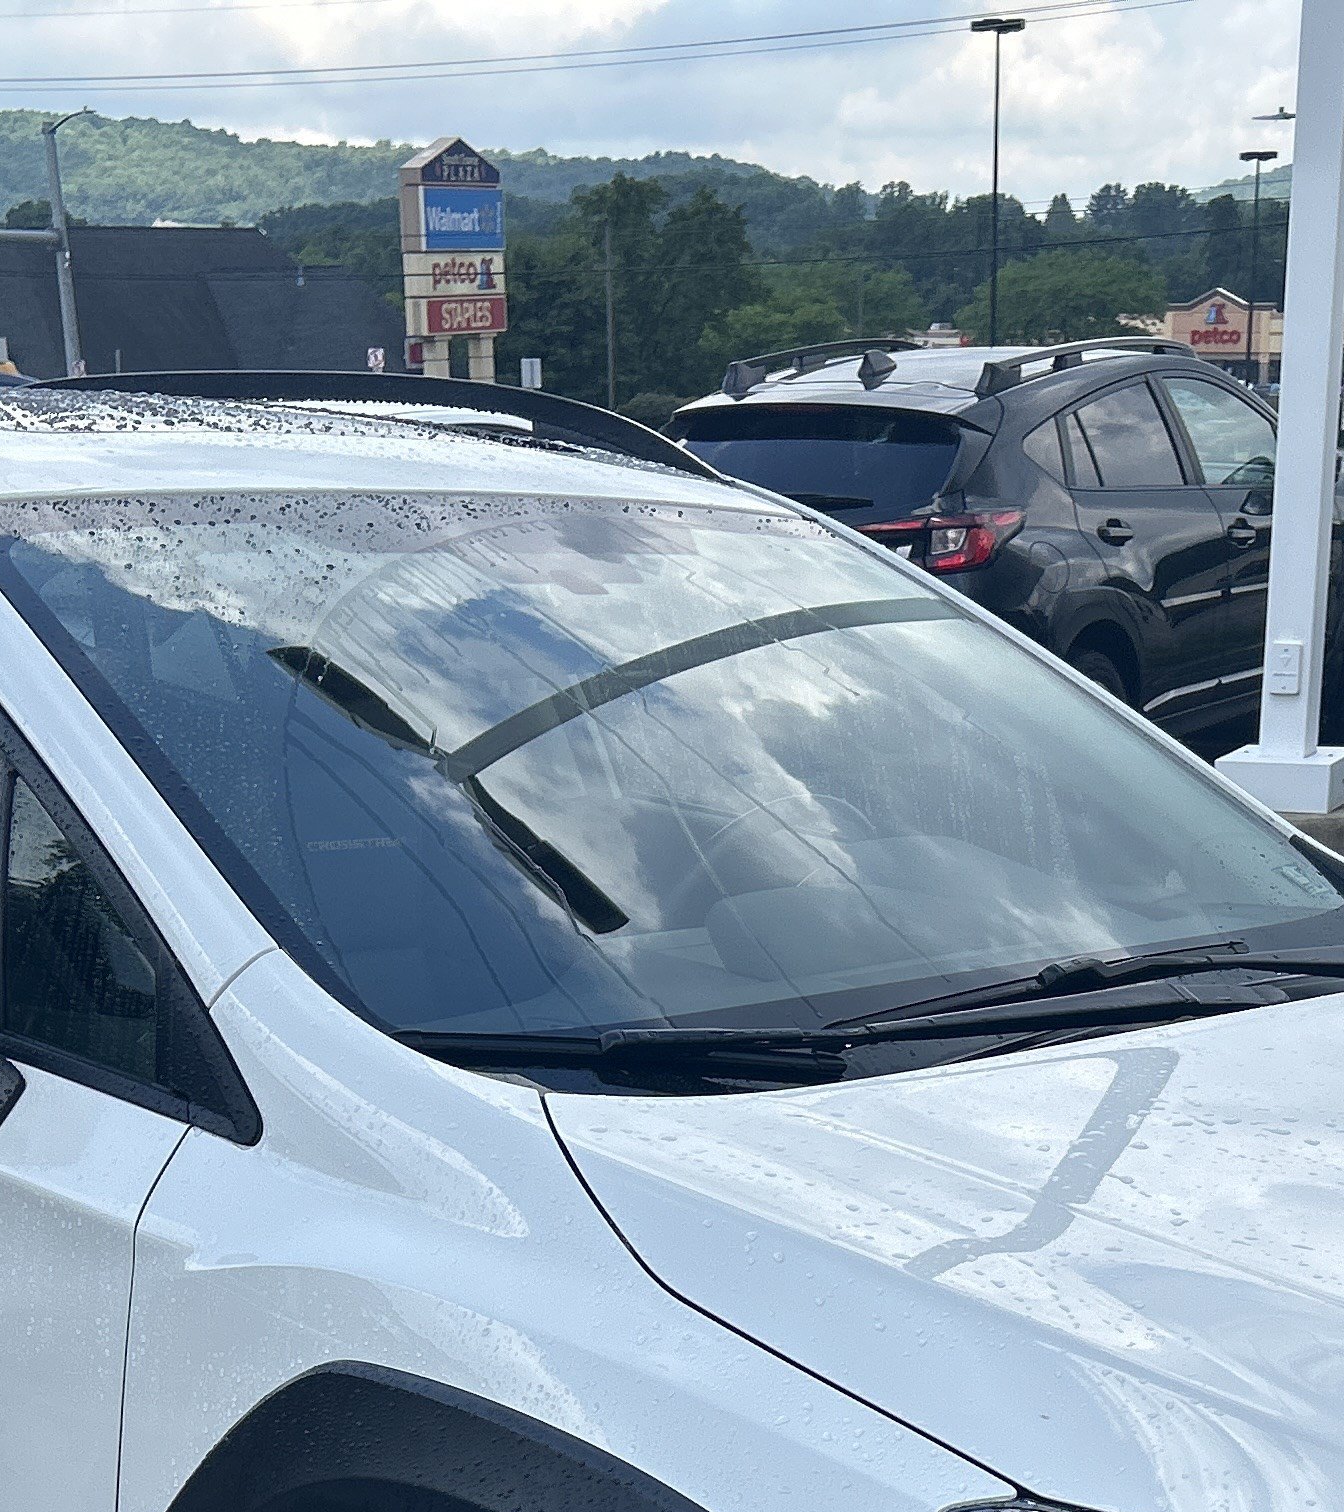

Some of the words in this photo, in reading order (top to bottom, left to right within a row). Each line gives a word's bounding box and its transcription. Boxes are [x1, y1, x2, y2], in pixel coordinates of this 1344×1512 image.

[426, 206, 481, 232] Walmart
[432, 257, 477, 291] petco
[441, 302, 493, 330] STAPLES
[1191, 327, 1241, 346] petco
